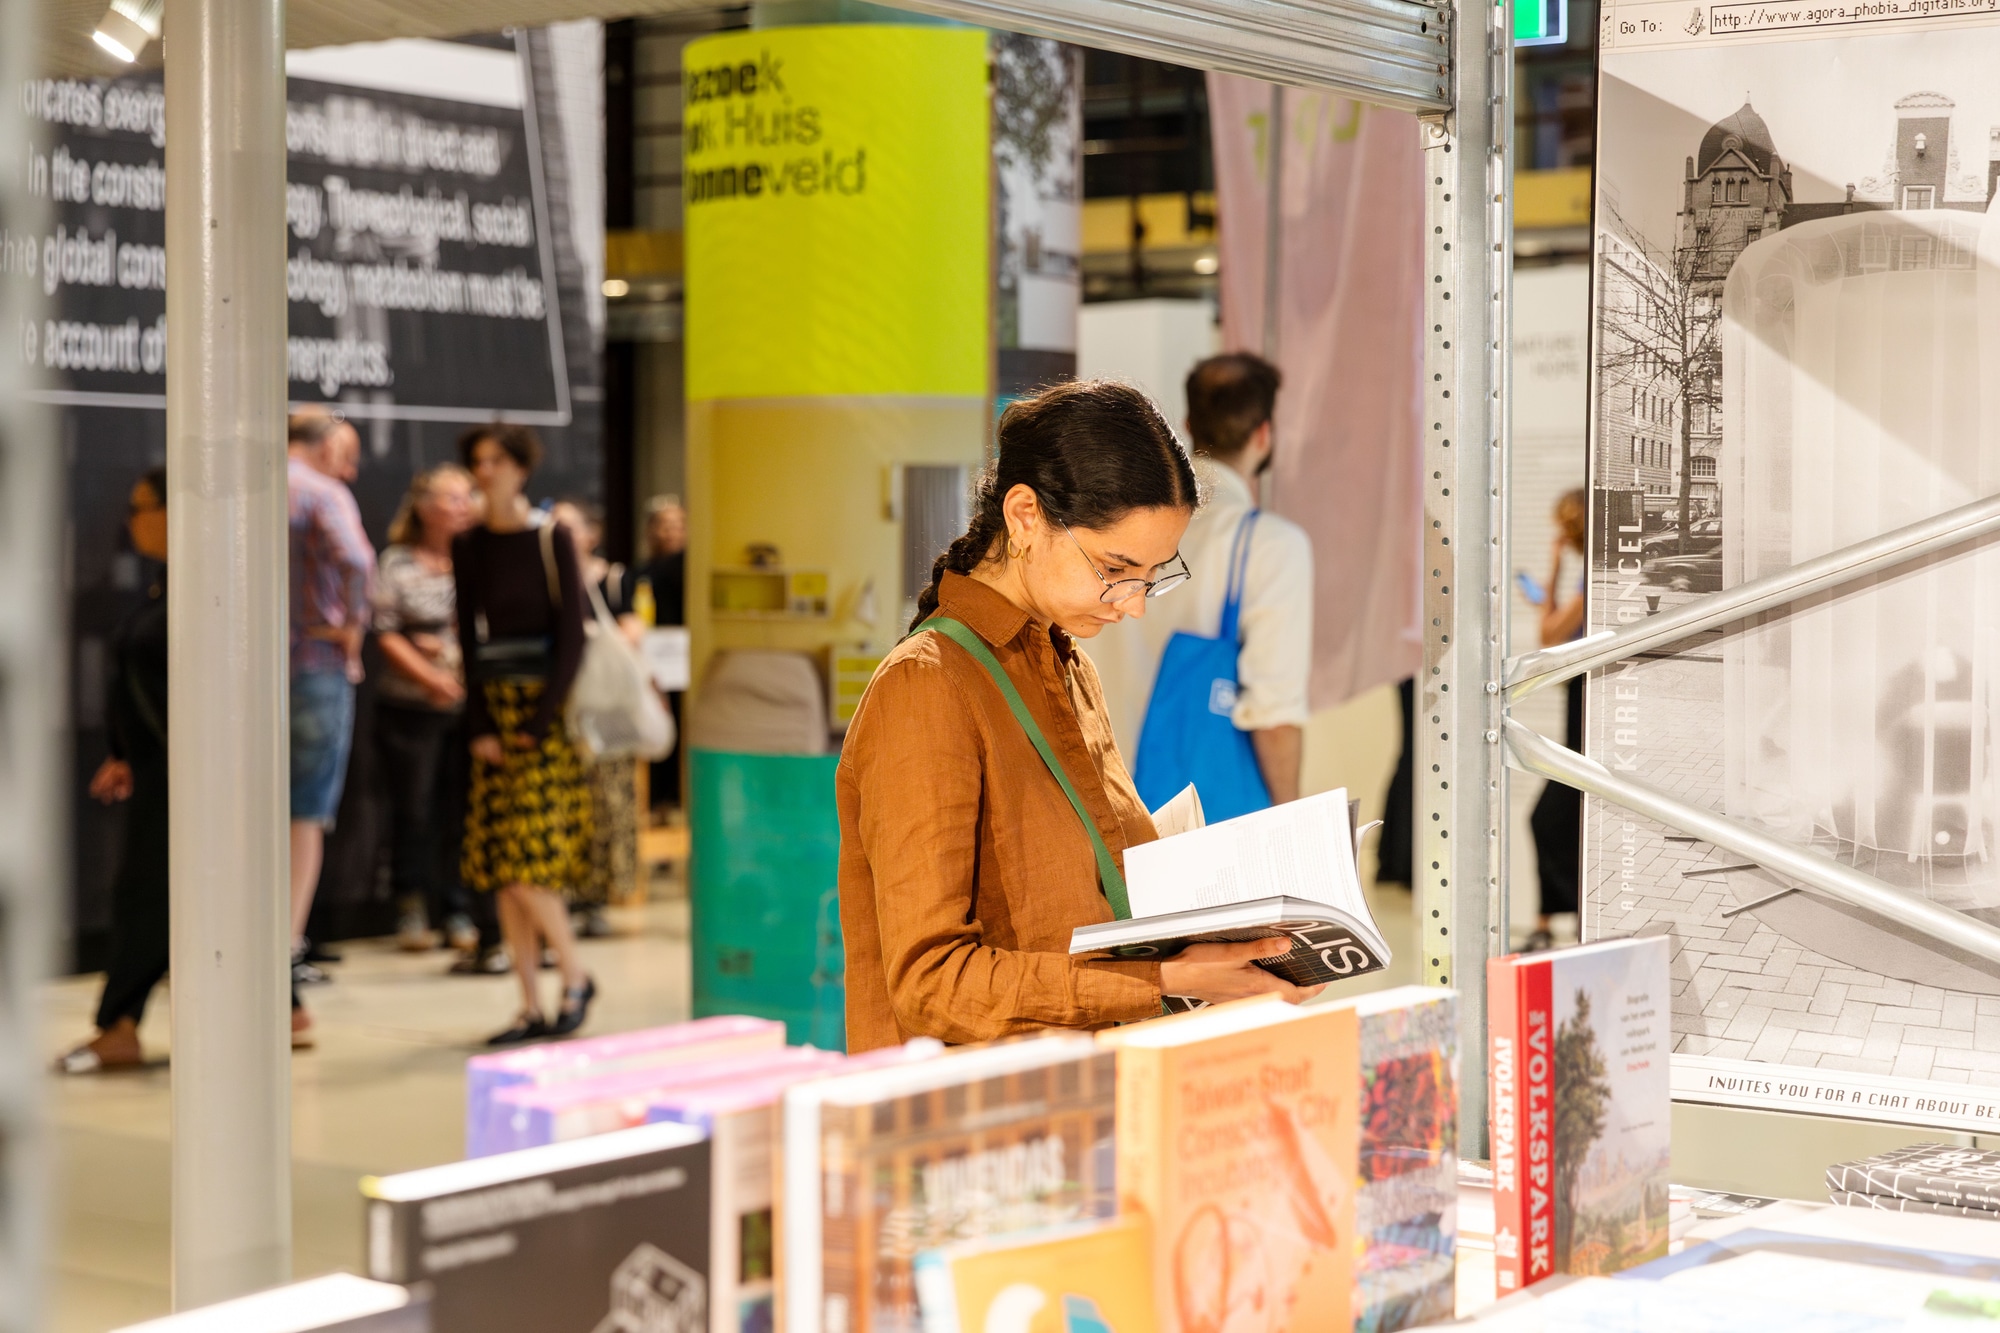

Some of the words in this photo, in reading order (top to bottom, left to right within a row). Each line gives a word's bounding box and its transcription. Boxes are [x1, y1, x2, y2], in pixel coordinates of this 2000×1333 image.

[1620, 21, 1636, 35] Go
[1641, 20, 1663, 33] To:
[724, 96, 823, 148] Huis
[43, 223, 117, 296] global
[1617, 518, 1643, 623] ANCEL
[1614, 660, 1639, 772] KAREN
[1620, 900, 1635, 911] A
[1494, 1047, 1516, 1193] VOLKSPARK
[1708, 1075, 1772, 1094] INVITES
[1779, 1083, 1809, 1098] YOU
[1815, 1087, 1845, 1102] FOR
[1851, 1091, 1862, 1103] A
[1868, 1093, 1910, 1109] CHAT
[1915, 1098, 1970, 1116] ABOUT
[1975, 1105, 2000, 1119] BE
[1528, 1024, 1549, 1276] VOLKSPARK
